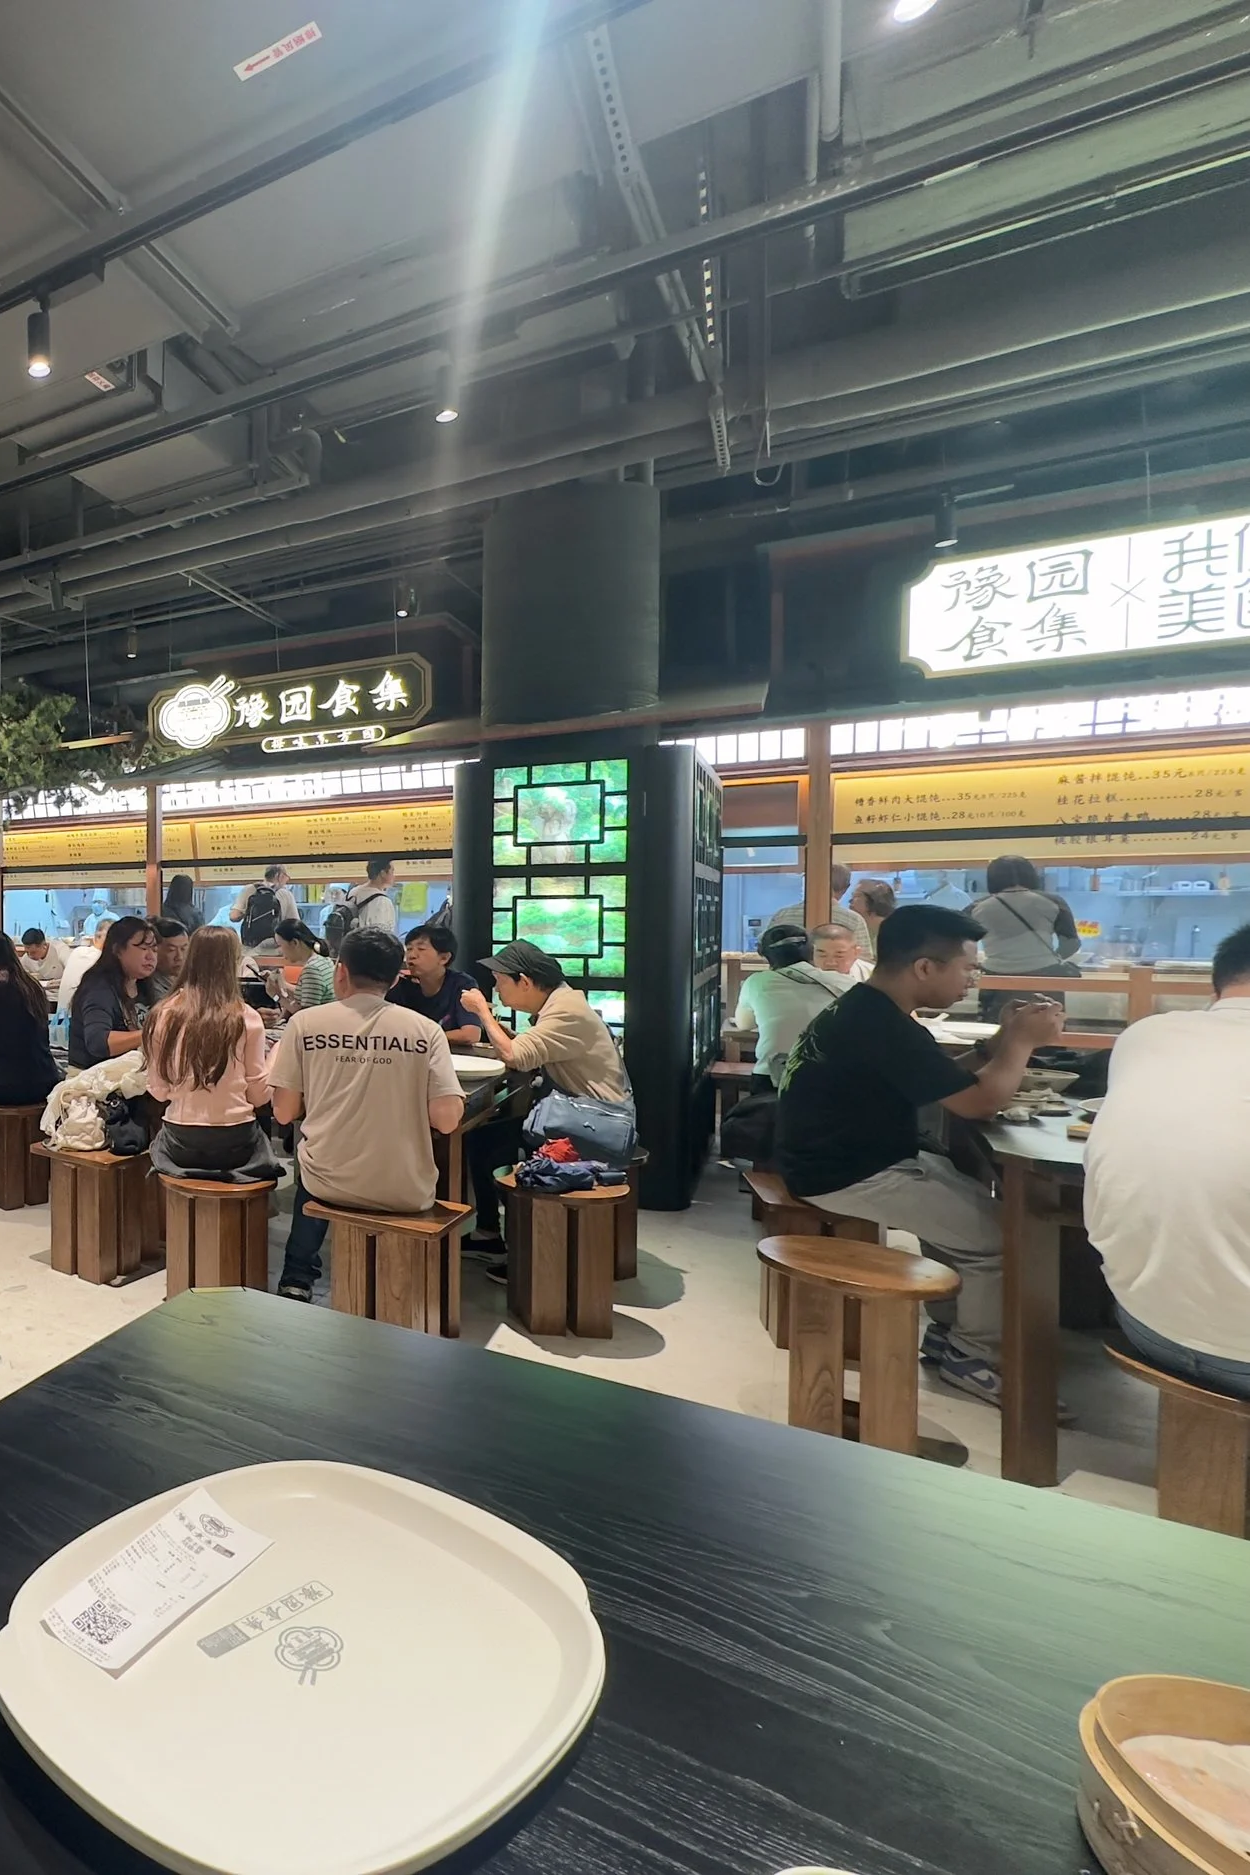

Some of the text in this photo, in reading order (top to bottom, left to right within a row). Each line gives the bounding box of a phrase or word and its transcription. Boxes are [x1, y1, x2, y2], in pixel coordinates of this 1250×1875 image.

[941, 549, 1093, 612] 豫园
[936, 603, 1086, 661] 食集
[233, 670, 408, 728] 豫园食集
[303, 1034, 428, 1054] ESSENTIALS
[335, 1055, 392, 1065] FEAR OF GOD
